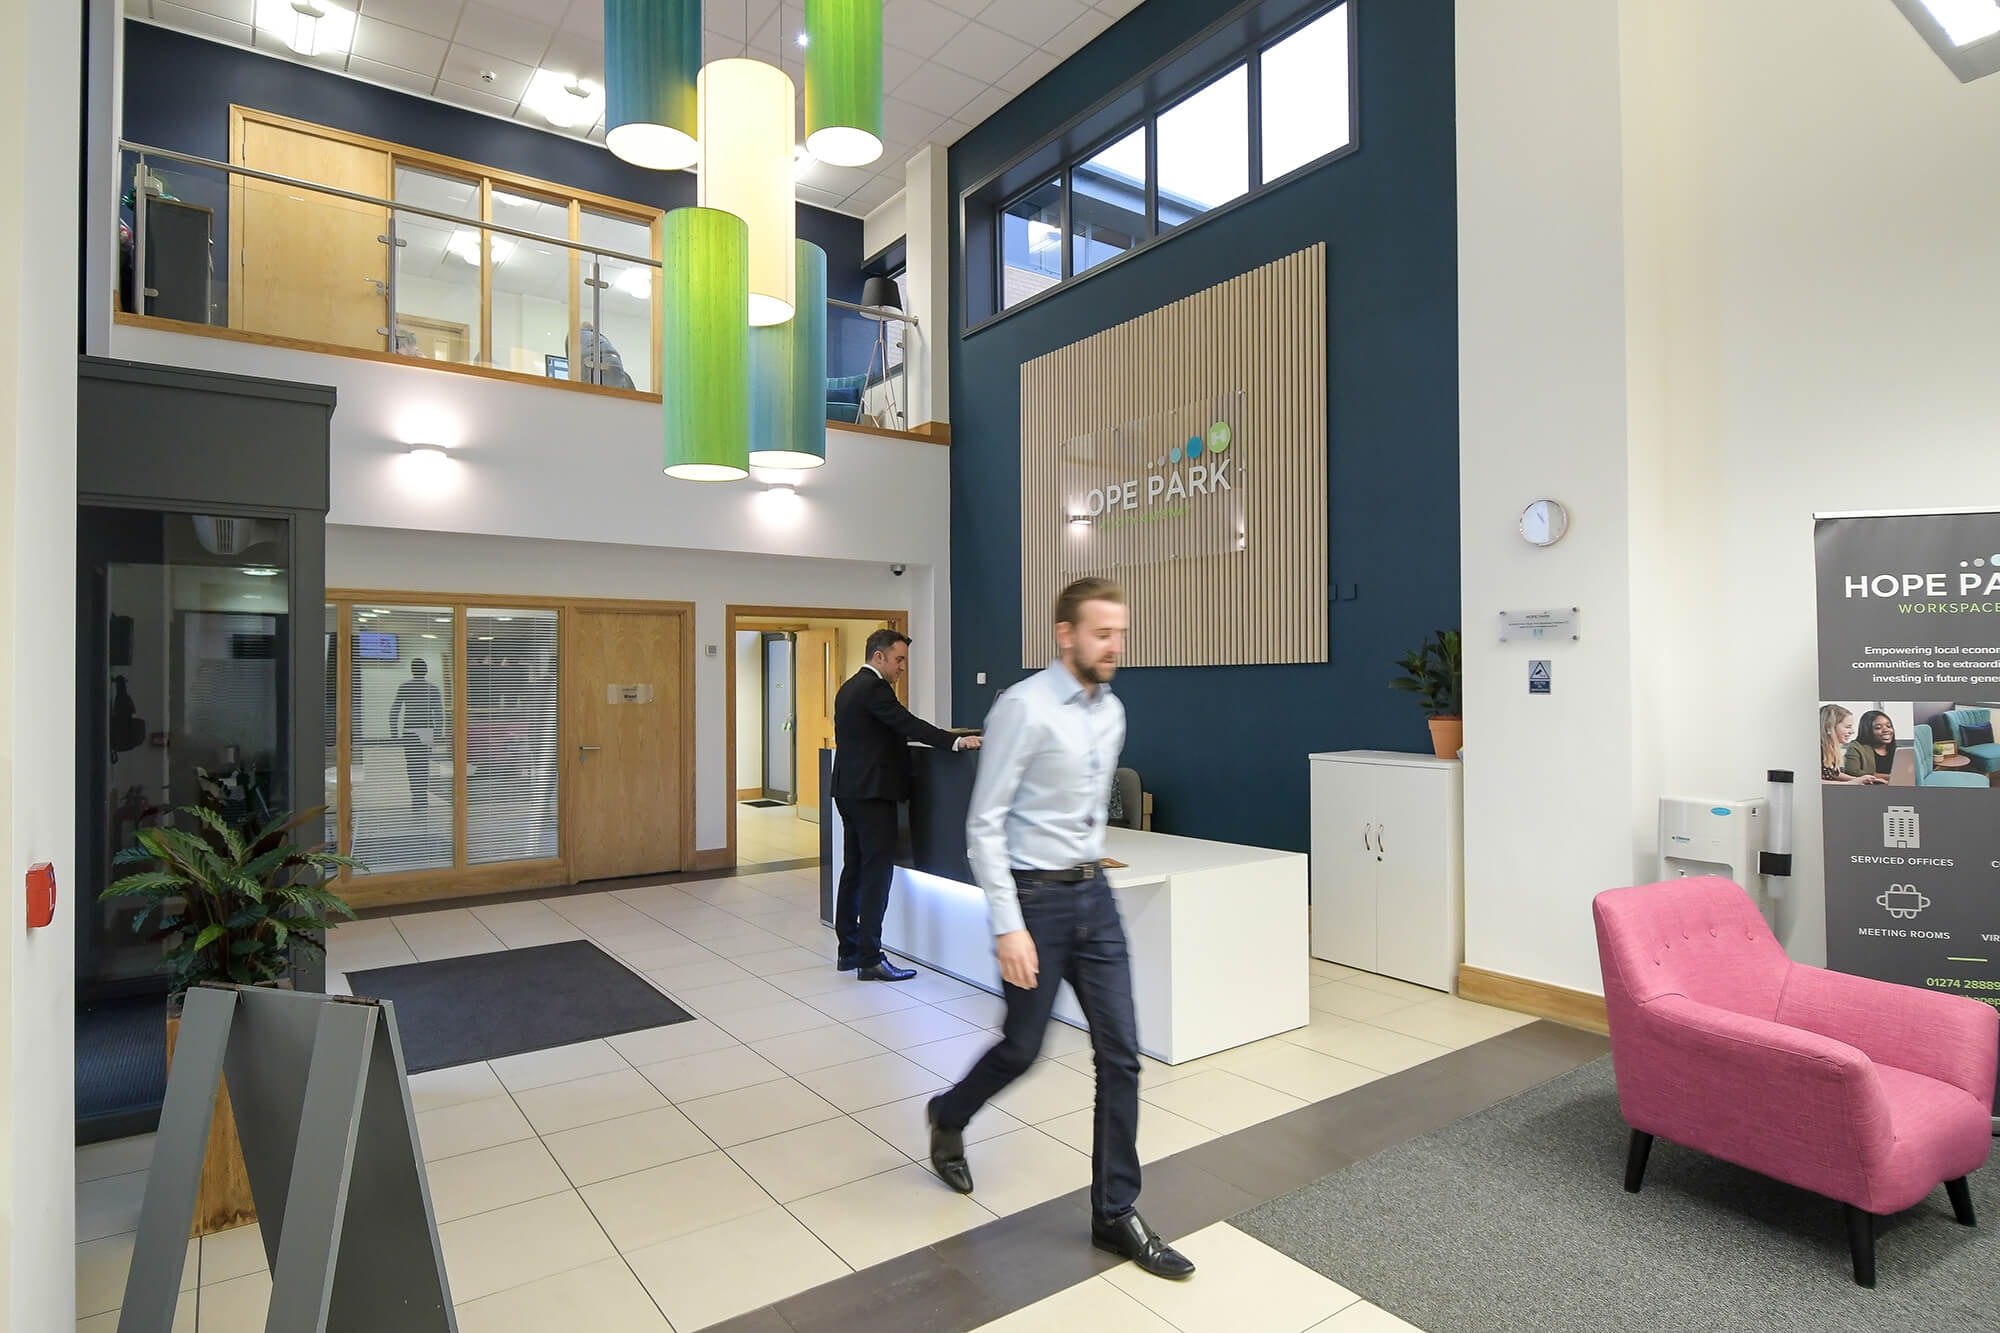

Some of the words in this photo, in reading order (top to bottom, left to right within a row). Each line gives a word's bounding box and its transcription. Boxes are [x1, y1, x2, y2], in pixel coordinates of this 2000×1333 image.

[1086, 480, 1138, 517] OPE
[1148, 458, 1231, 505] PARK
[1845, 573, 1947, 598] HOPE
[1960, 573, 2000, 596] PA
[1899, 602, 2000, 614] WORKSPACE
[1865, 646, 1932, 656] Empowering
[1935, 646, 1959, 654] local
[1852, 660, 1920, 669] communities
[1937, 660, 1950, 668] be
[1873, 674, 1921, 684] investing
[1924, 674, 1934, 682] in
[1937, 674, 1968, 682] future
[1851, 856, 1904, 865] SERVICED
[1908, 858, 1954, 867] OFFICES
[1859, 927, 1907, 938] MEETING
[1910, 930, 1950, 940] ROOMS
[1926, 977, 1961, 988] 01274
